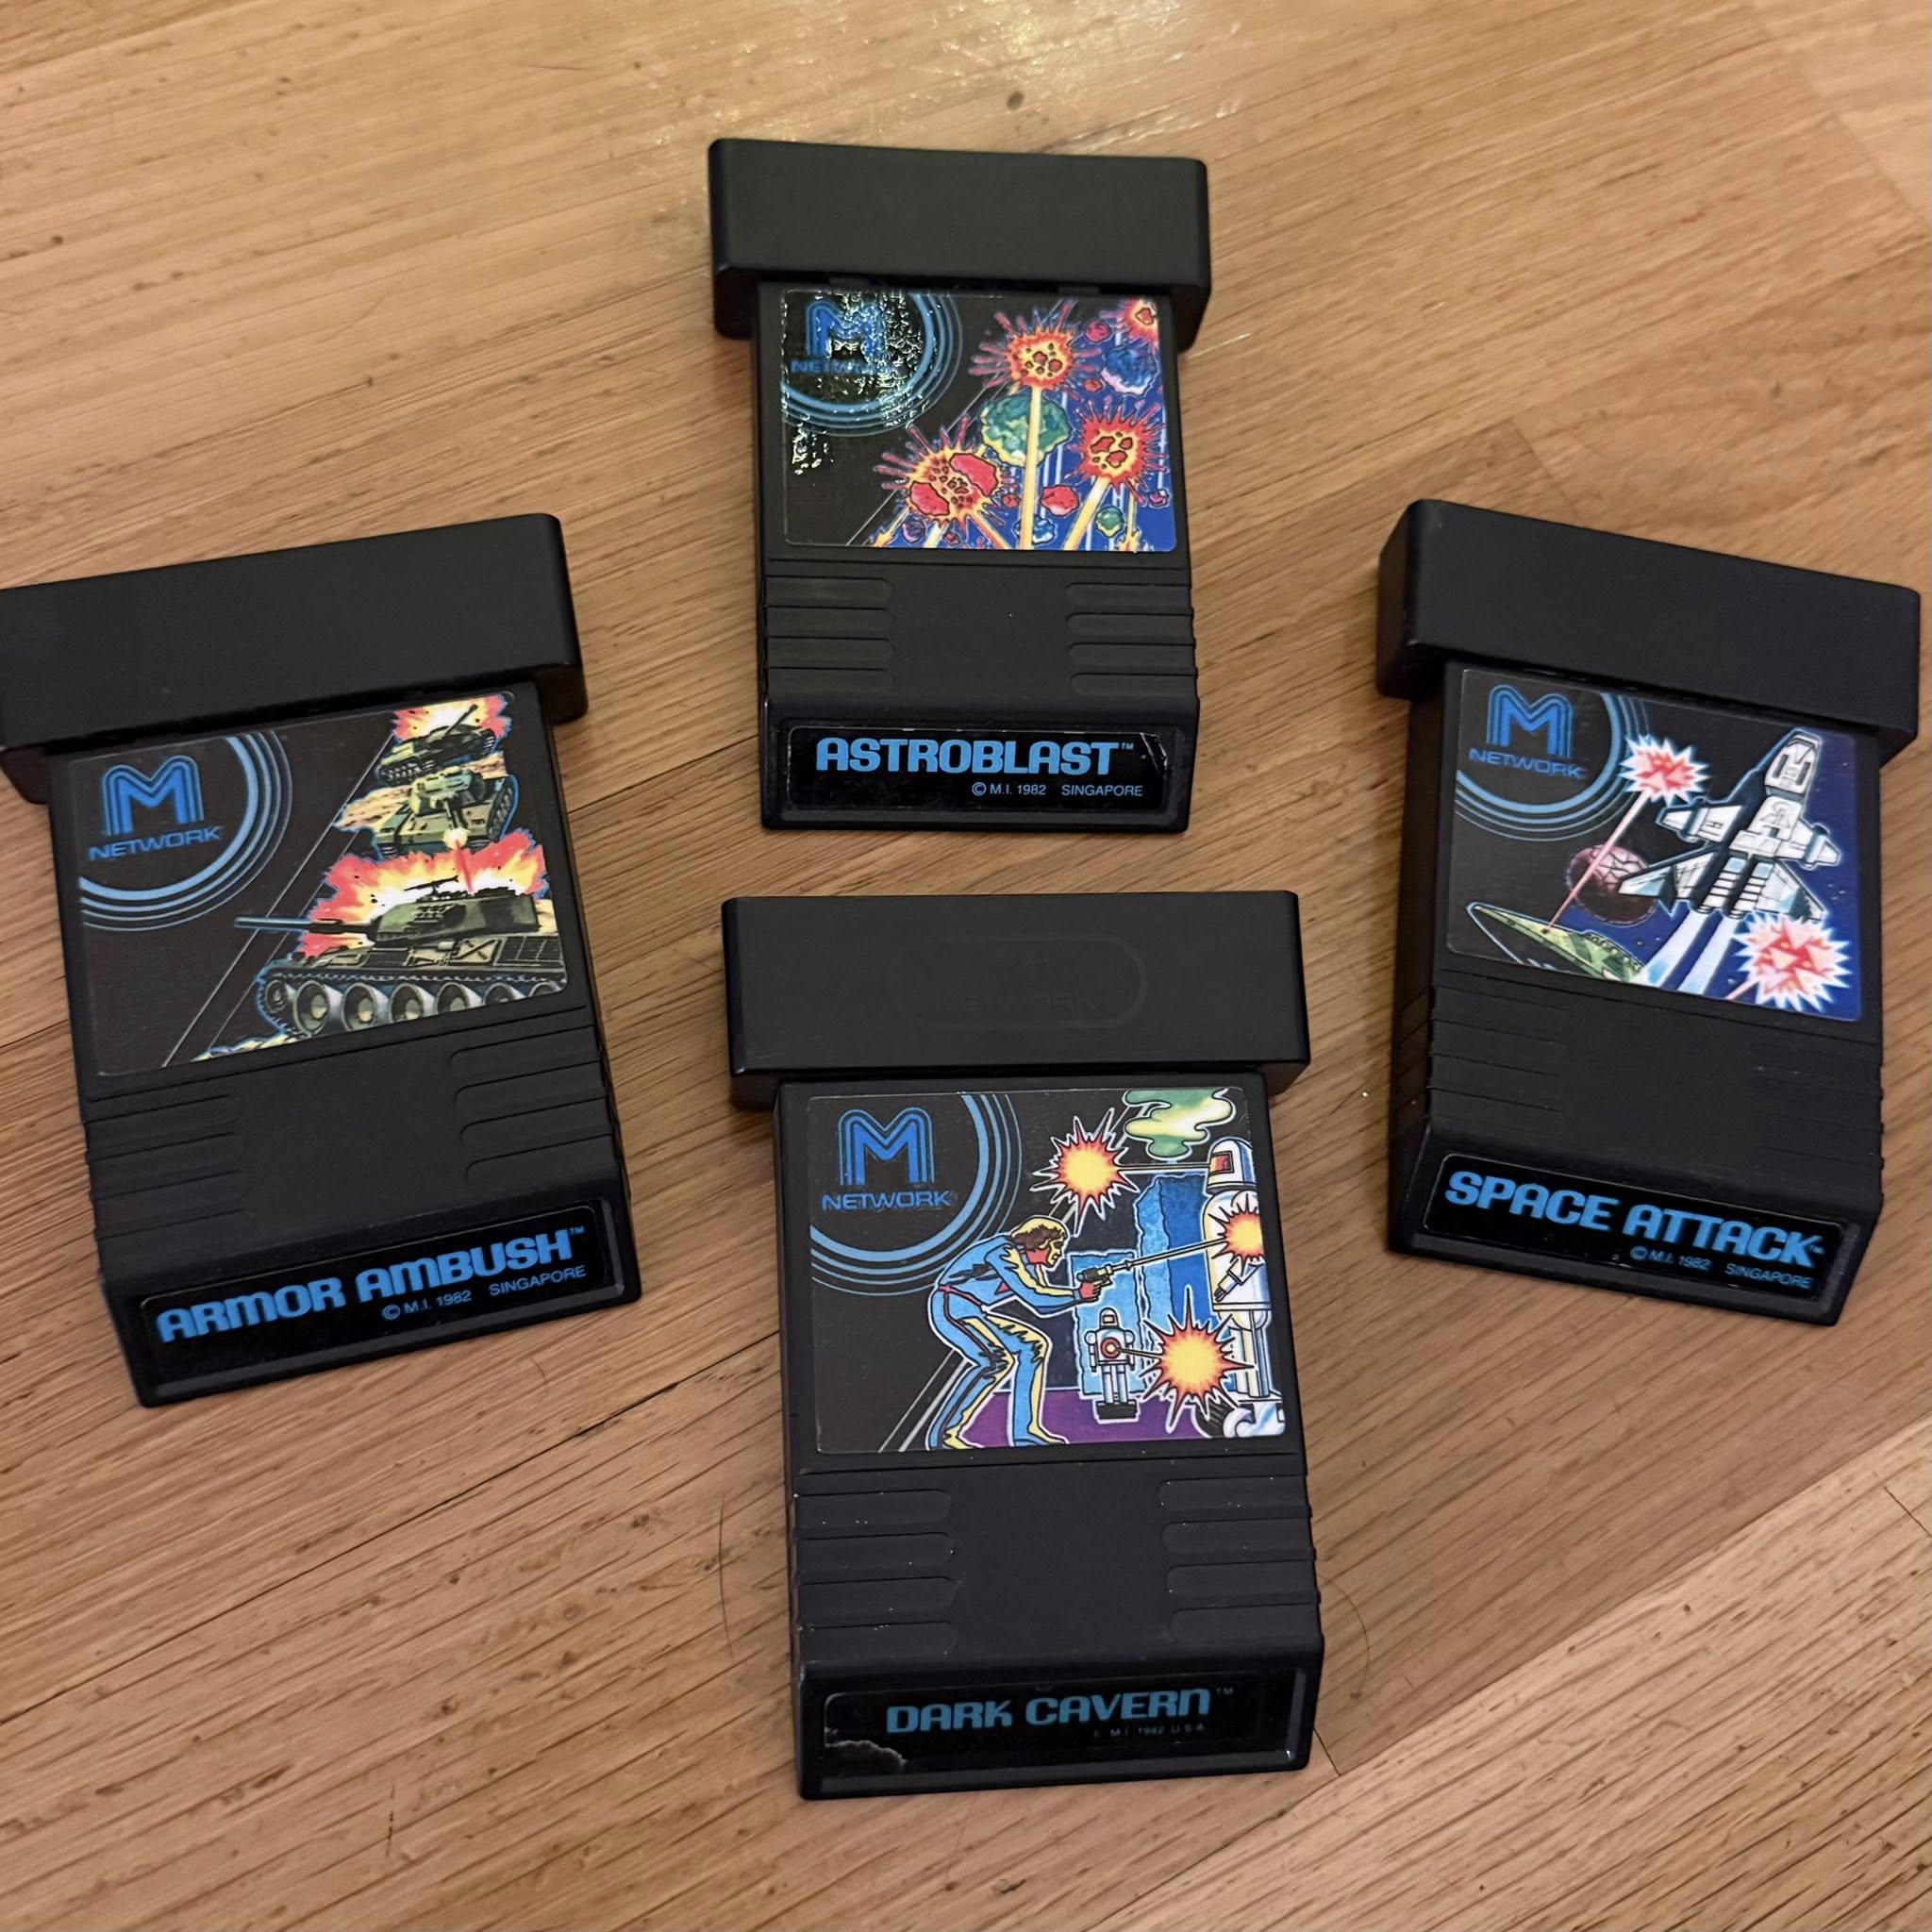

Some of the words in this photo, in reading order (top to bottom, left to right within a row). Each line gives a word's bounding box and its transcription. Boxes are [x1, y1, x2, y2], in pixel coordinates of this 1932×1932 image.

[1486, 684, 1574, 758] M
[1469, 748, 1588, 779] NETWORK
[101, 755, 205, 837] M
[1017, 784, 1047, 796] 1982
[1061, 784, 1144, 797] SINGAPORE
[87, 825, 224, 861] NETWORK
[838, 1107, 937, 1187] M
[821, 1190, 953, 1212] NETWORK
[1444, 1171, 1620, 1231] SPACE
[437, 1289, 473, 1307] 1982
[488, 1264, 588, 1297] SINGAPORE
[1678, 1256, 1712, 1272] 1982
[1724, 1263, 1814, 1291] SINGAPORE
[156, 1277, 346, 1343] ARMOR
[887, 1700, 1012, 1734] DARK
